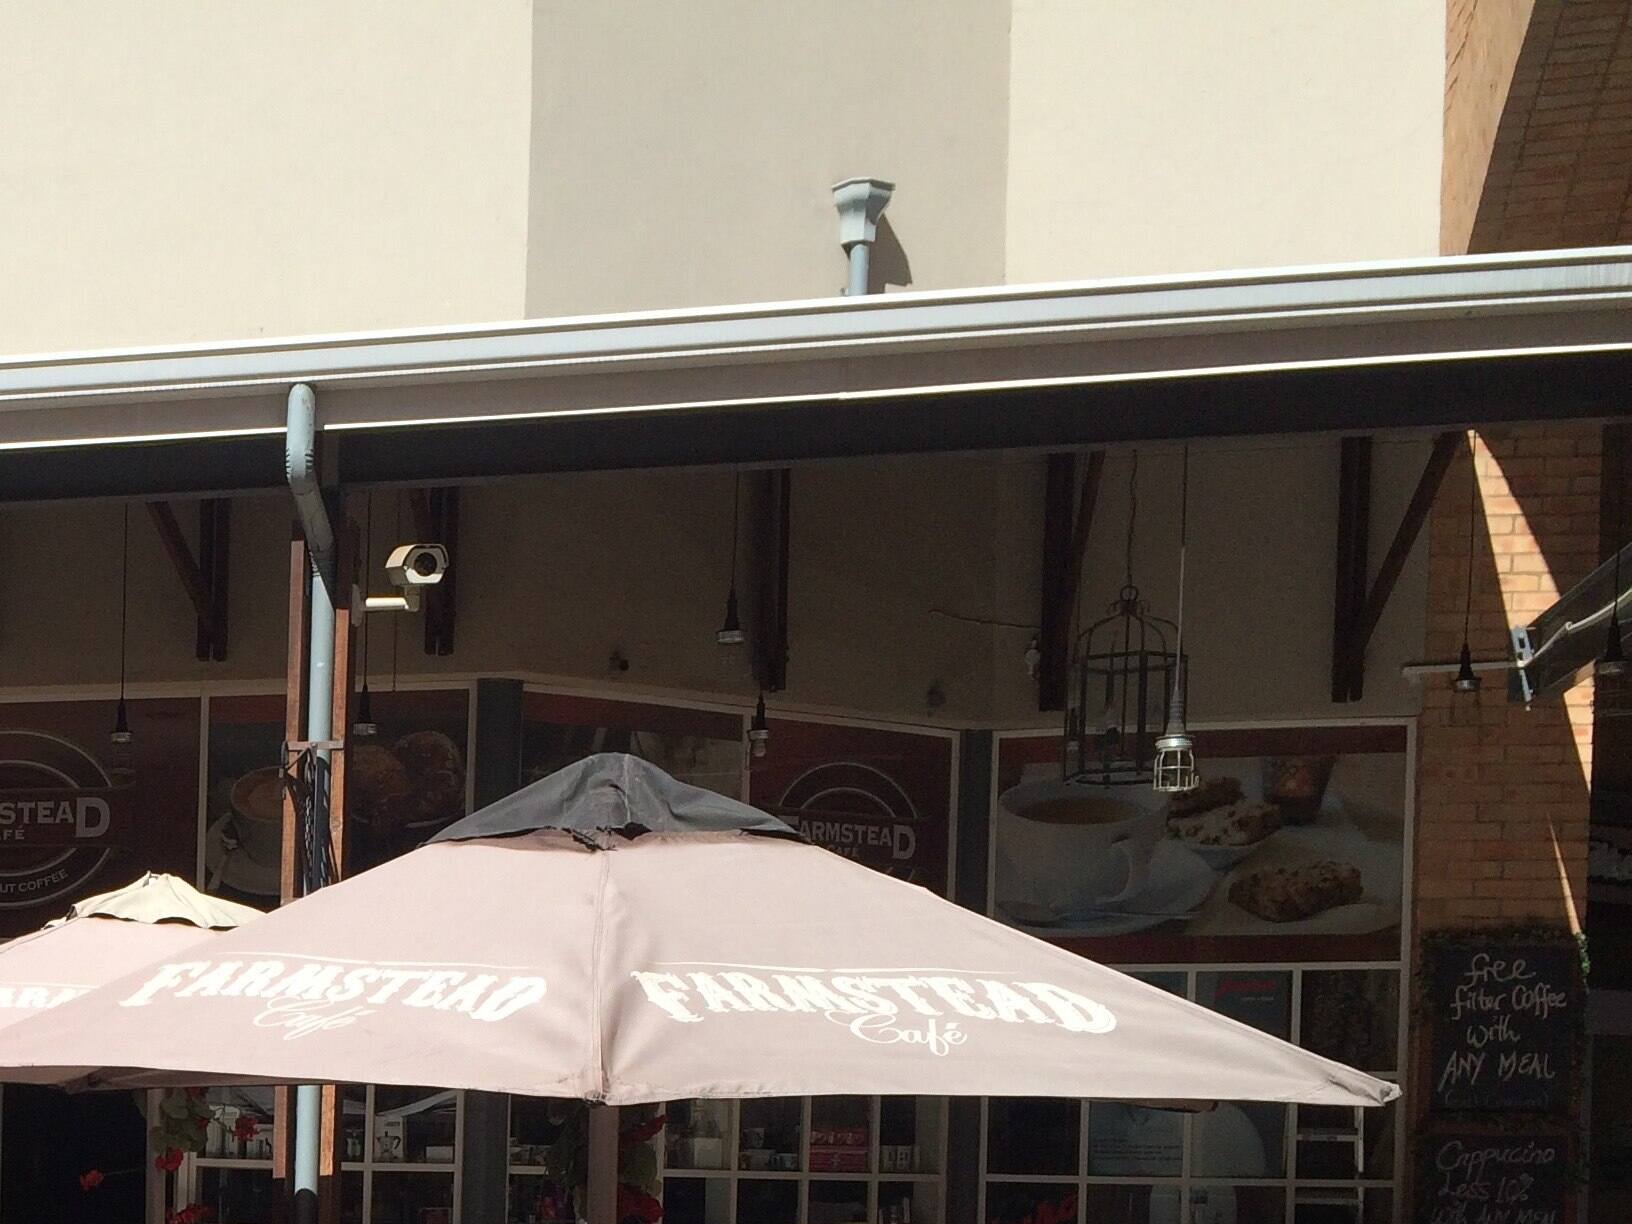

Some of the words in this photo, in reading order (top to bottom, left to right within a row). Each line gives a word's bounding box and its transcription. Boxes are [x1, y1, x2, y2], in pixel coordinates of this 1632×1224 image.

[778, 815, 916, 860] ARMSTEAD
[18, 869, 69, 892] COFFEE
[119, 961, 547, 1021] FARMSTEAD
[630, 970, 1117, 1033] FARMSTEAD
[824, 1010, 968, 1056] Café
[1467, 1015, 1520, 1048] with
[1437, 1050, 1486, 1092] ANY
[1498, 1050, 1555, 1081] MEAL
